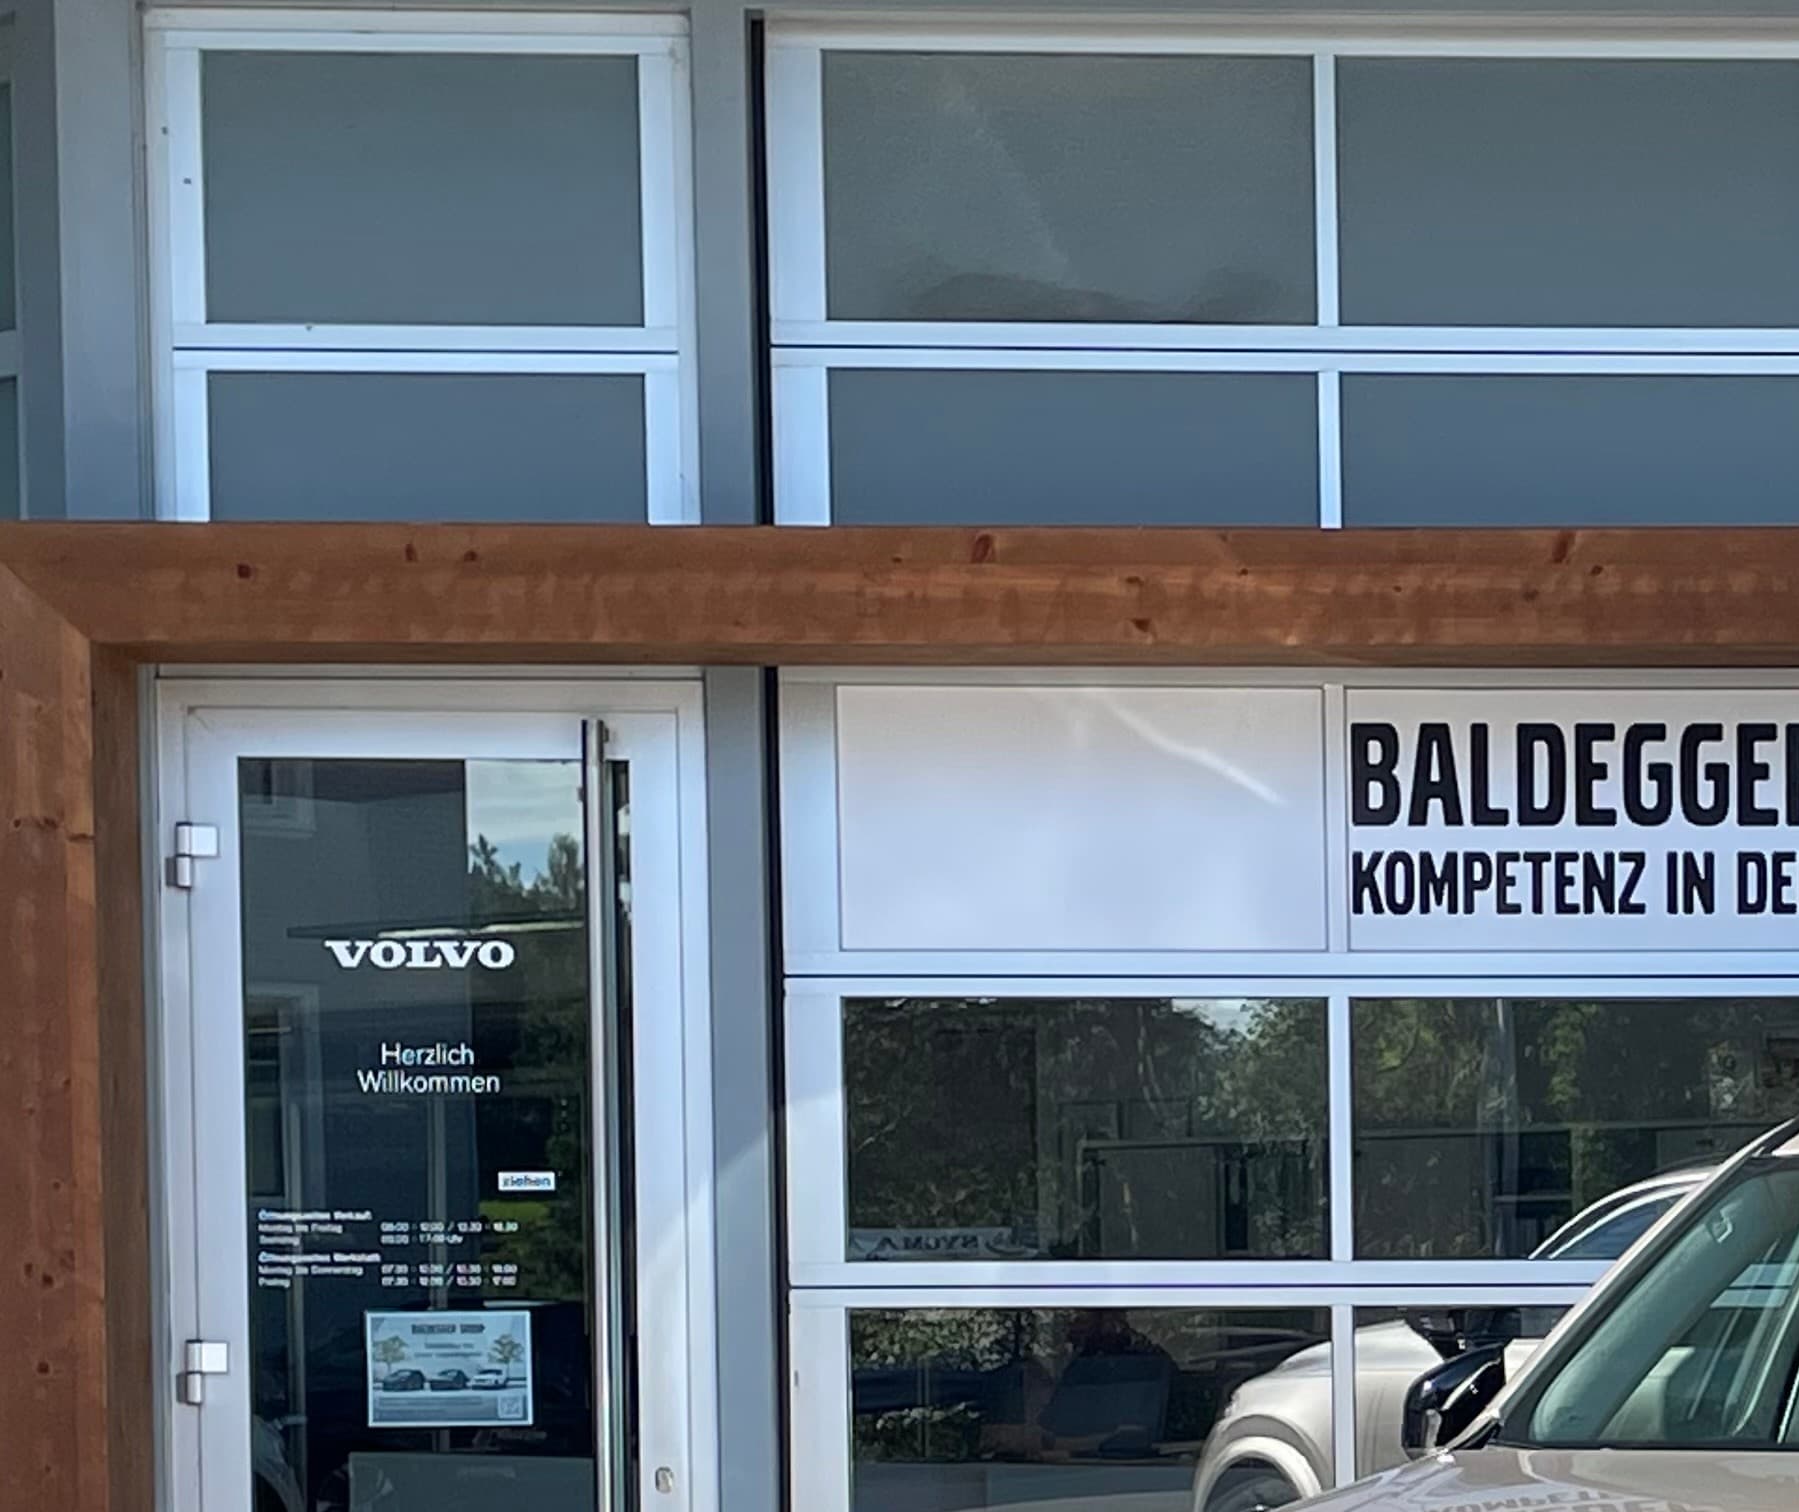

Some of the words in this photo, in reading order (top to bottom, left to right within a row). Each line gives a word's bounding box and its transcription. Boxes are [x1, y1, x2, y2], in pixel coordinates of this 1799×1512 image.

[1351, 851, 1646, 915] KOMPETENZ
[1666, 851, 1715, 915] IN
[324, 940, 515, 969] VOLVO
[381, 1042, 475, 1066] Herzlich
[357, 1069, 501, 1093] Willkommen
